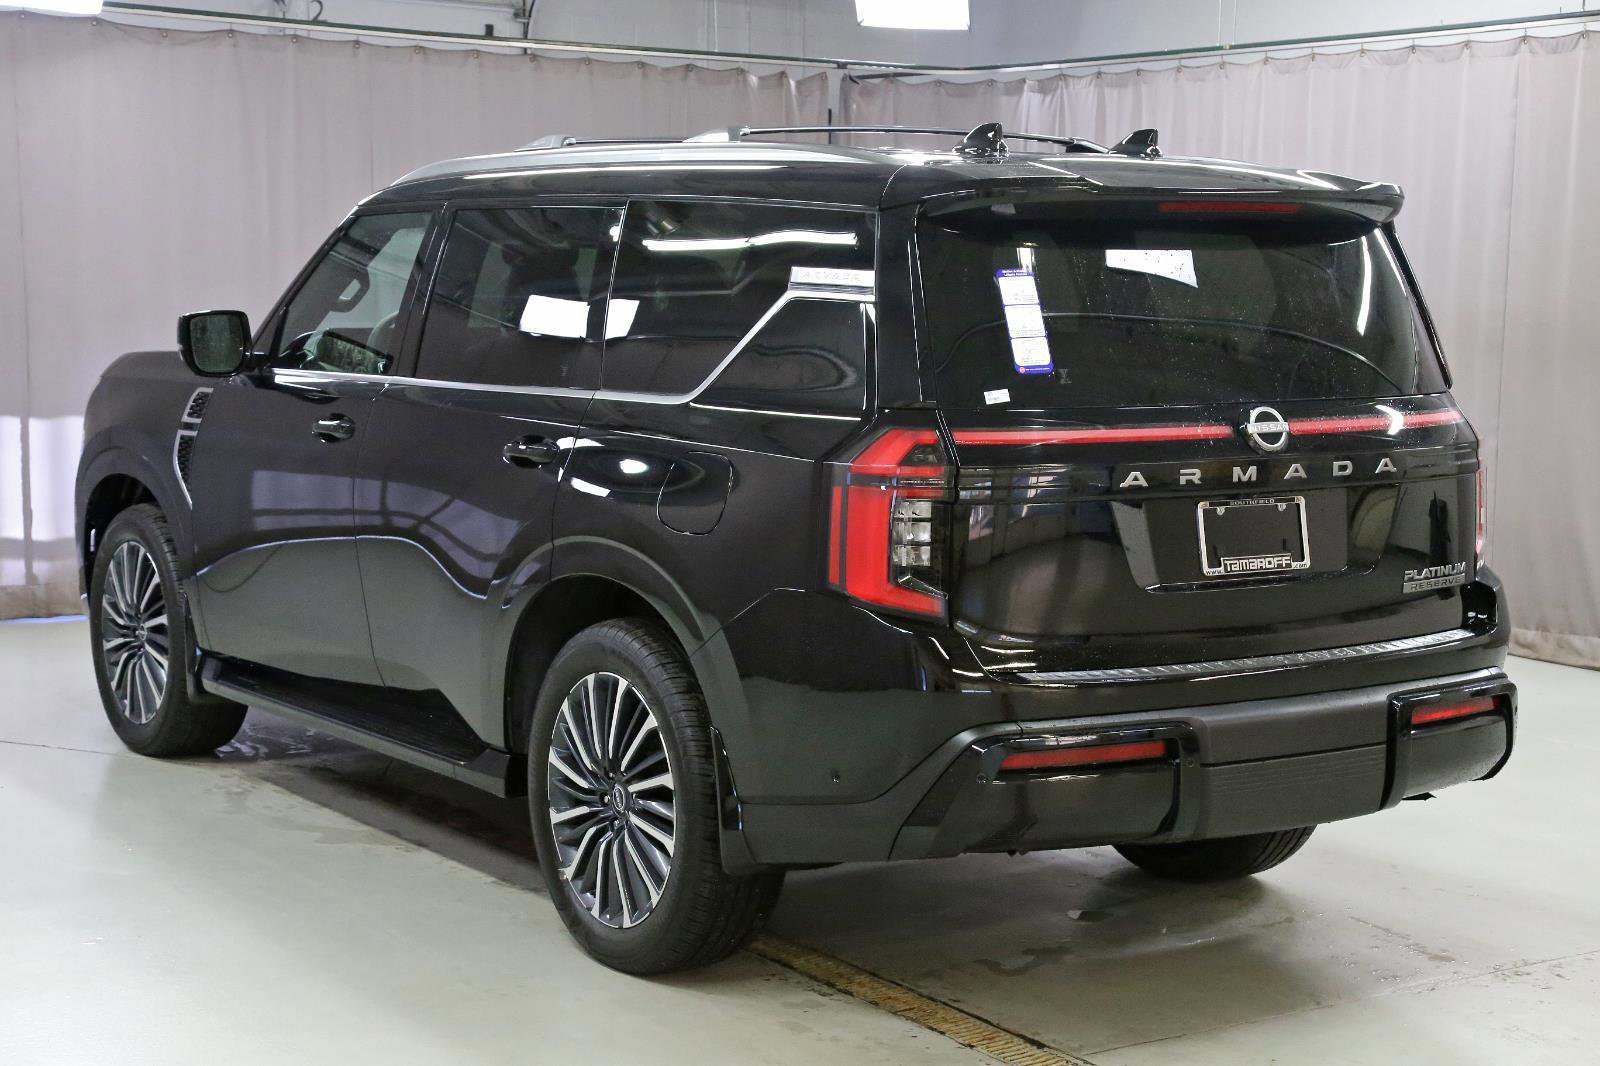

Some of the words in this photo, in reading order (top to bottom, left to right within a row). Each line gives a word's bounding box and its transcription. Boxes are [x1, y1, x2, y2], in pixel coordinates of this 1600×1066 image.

[1119, 457, 1397, 488] ARMADA
[1404, 562, 1466, 581] PLATINUM
[1411, 577, 1461, 591] RESERVE
